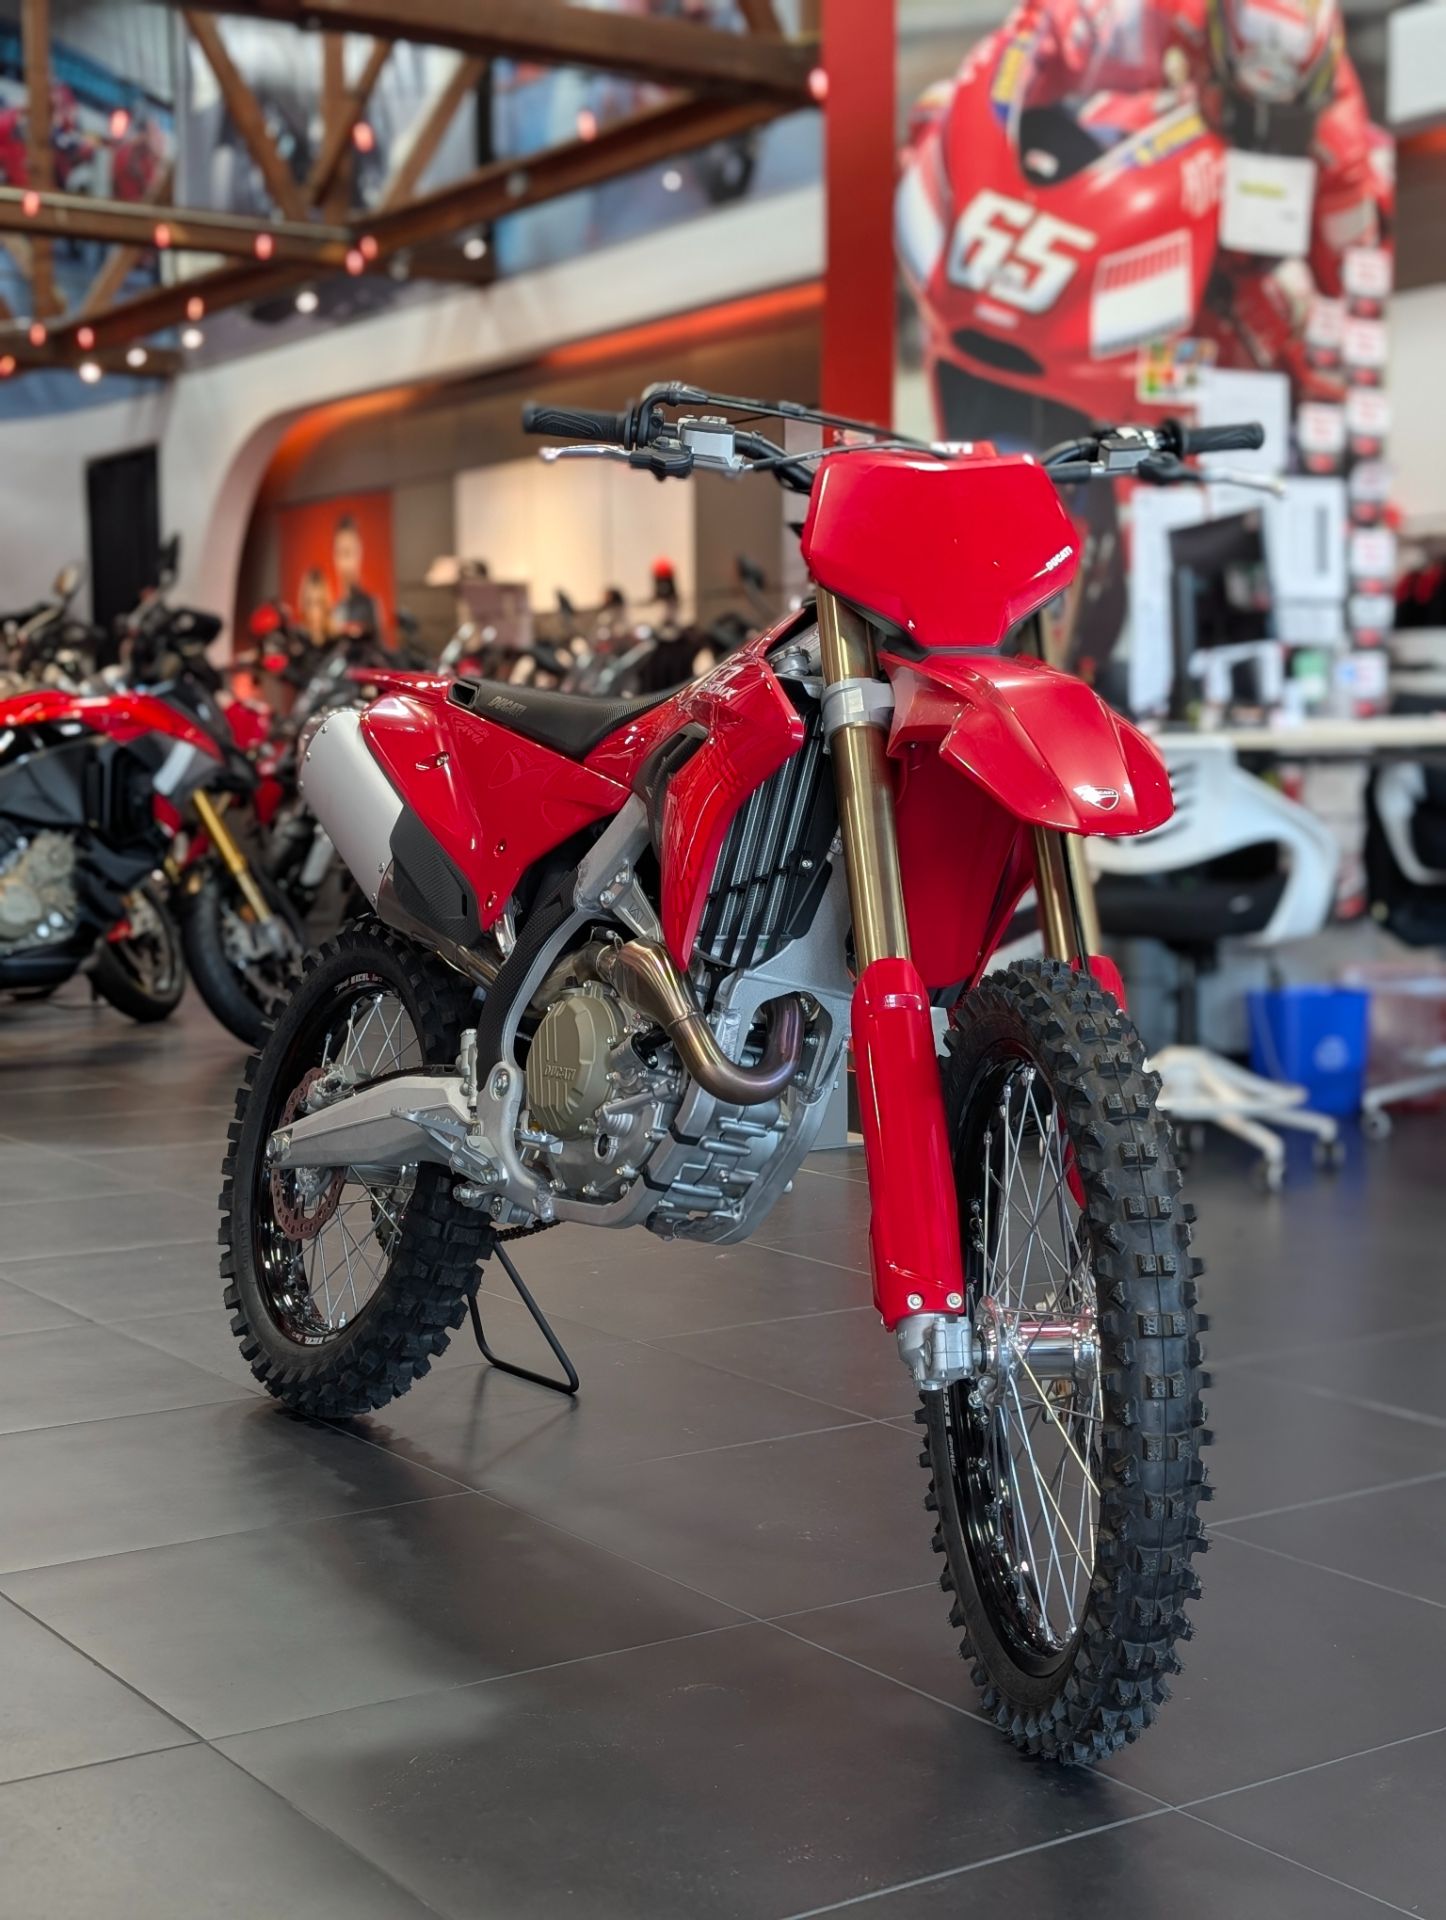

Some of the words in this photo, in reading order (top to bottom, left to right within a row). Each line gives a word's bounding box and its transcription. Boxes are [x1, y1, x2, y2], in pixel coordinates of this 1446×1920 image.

[947, 188, 1098, 315] 65
[1045, 545, 1073, 571] DUCATI
[487, 695, 528, 718] DUCATI
[544, 1064, 577, 1080] DUCATI
